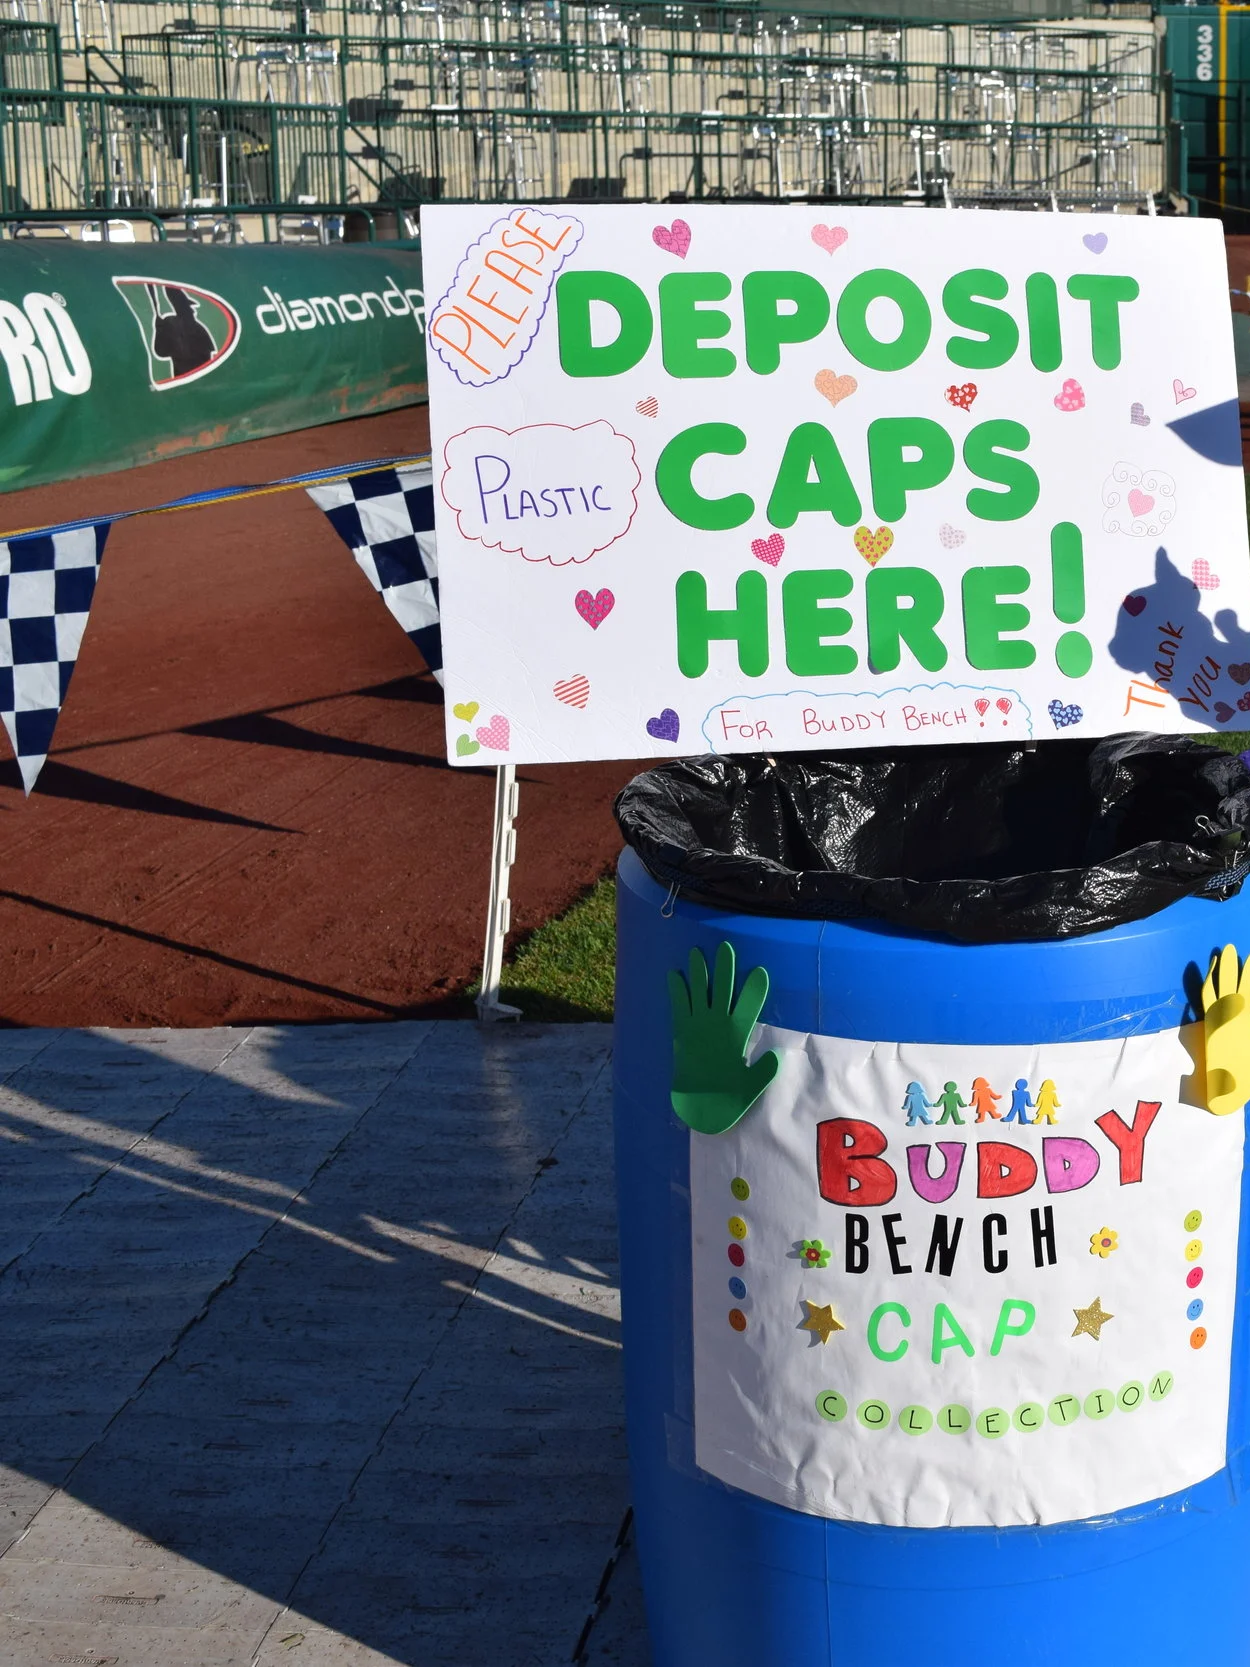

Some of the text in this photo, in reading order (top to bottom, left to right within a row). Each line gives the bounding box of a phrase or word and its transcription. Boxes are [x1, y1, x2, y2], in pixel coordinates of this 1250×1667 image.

[1196, 24, 1213, 81] 336
[432, 210, 572, 376] PLEASE
[555, 268, 1140, 379] DEPOSIT
[474, 454, 612, 524] PLASTIC
[654, 416, 1041, 531] CAPS
[675, 521, 1094, 679] HERE!
[1123, 621, 1185, 717] Thank
[720, 709, 773, 741] FOR
[802, 708, 886, 735] BUDDY
[815, 1100, 1162, 1207] BUDDY
[844, 1205, 1057, 1277] BENCH
[866, 1298, 1037, 1364] CAP
[820, 1374, 1173, 1436] COLLECTION
